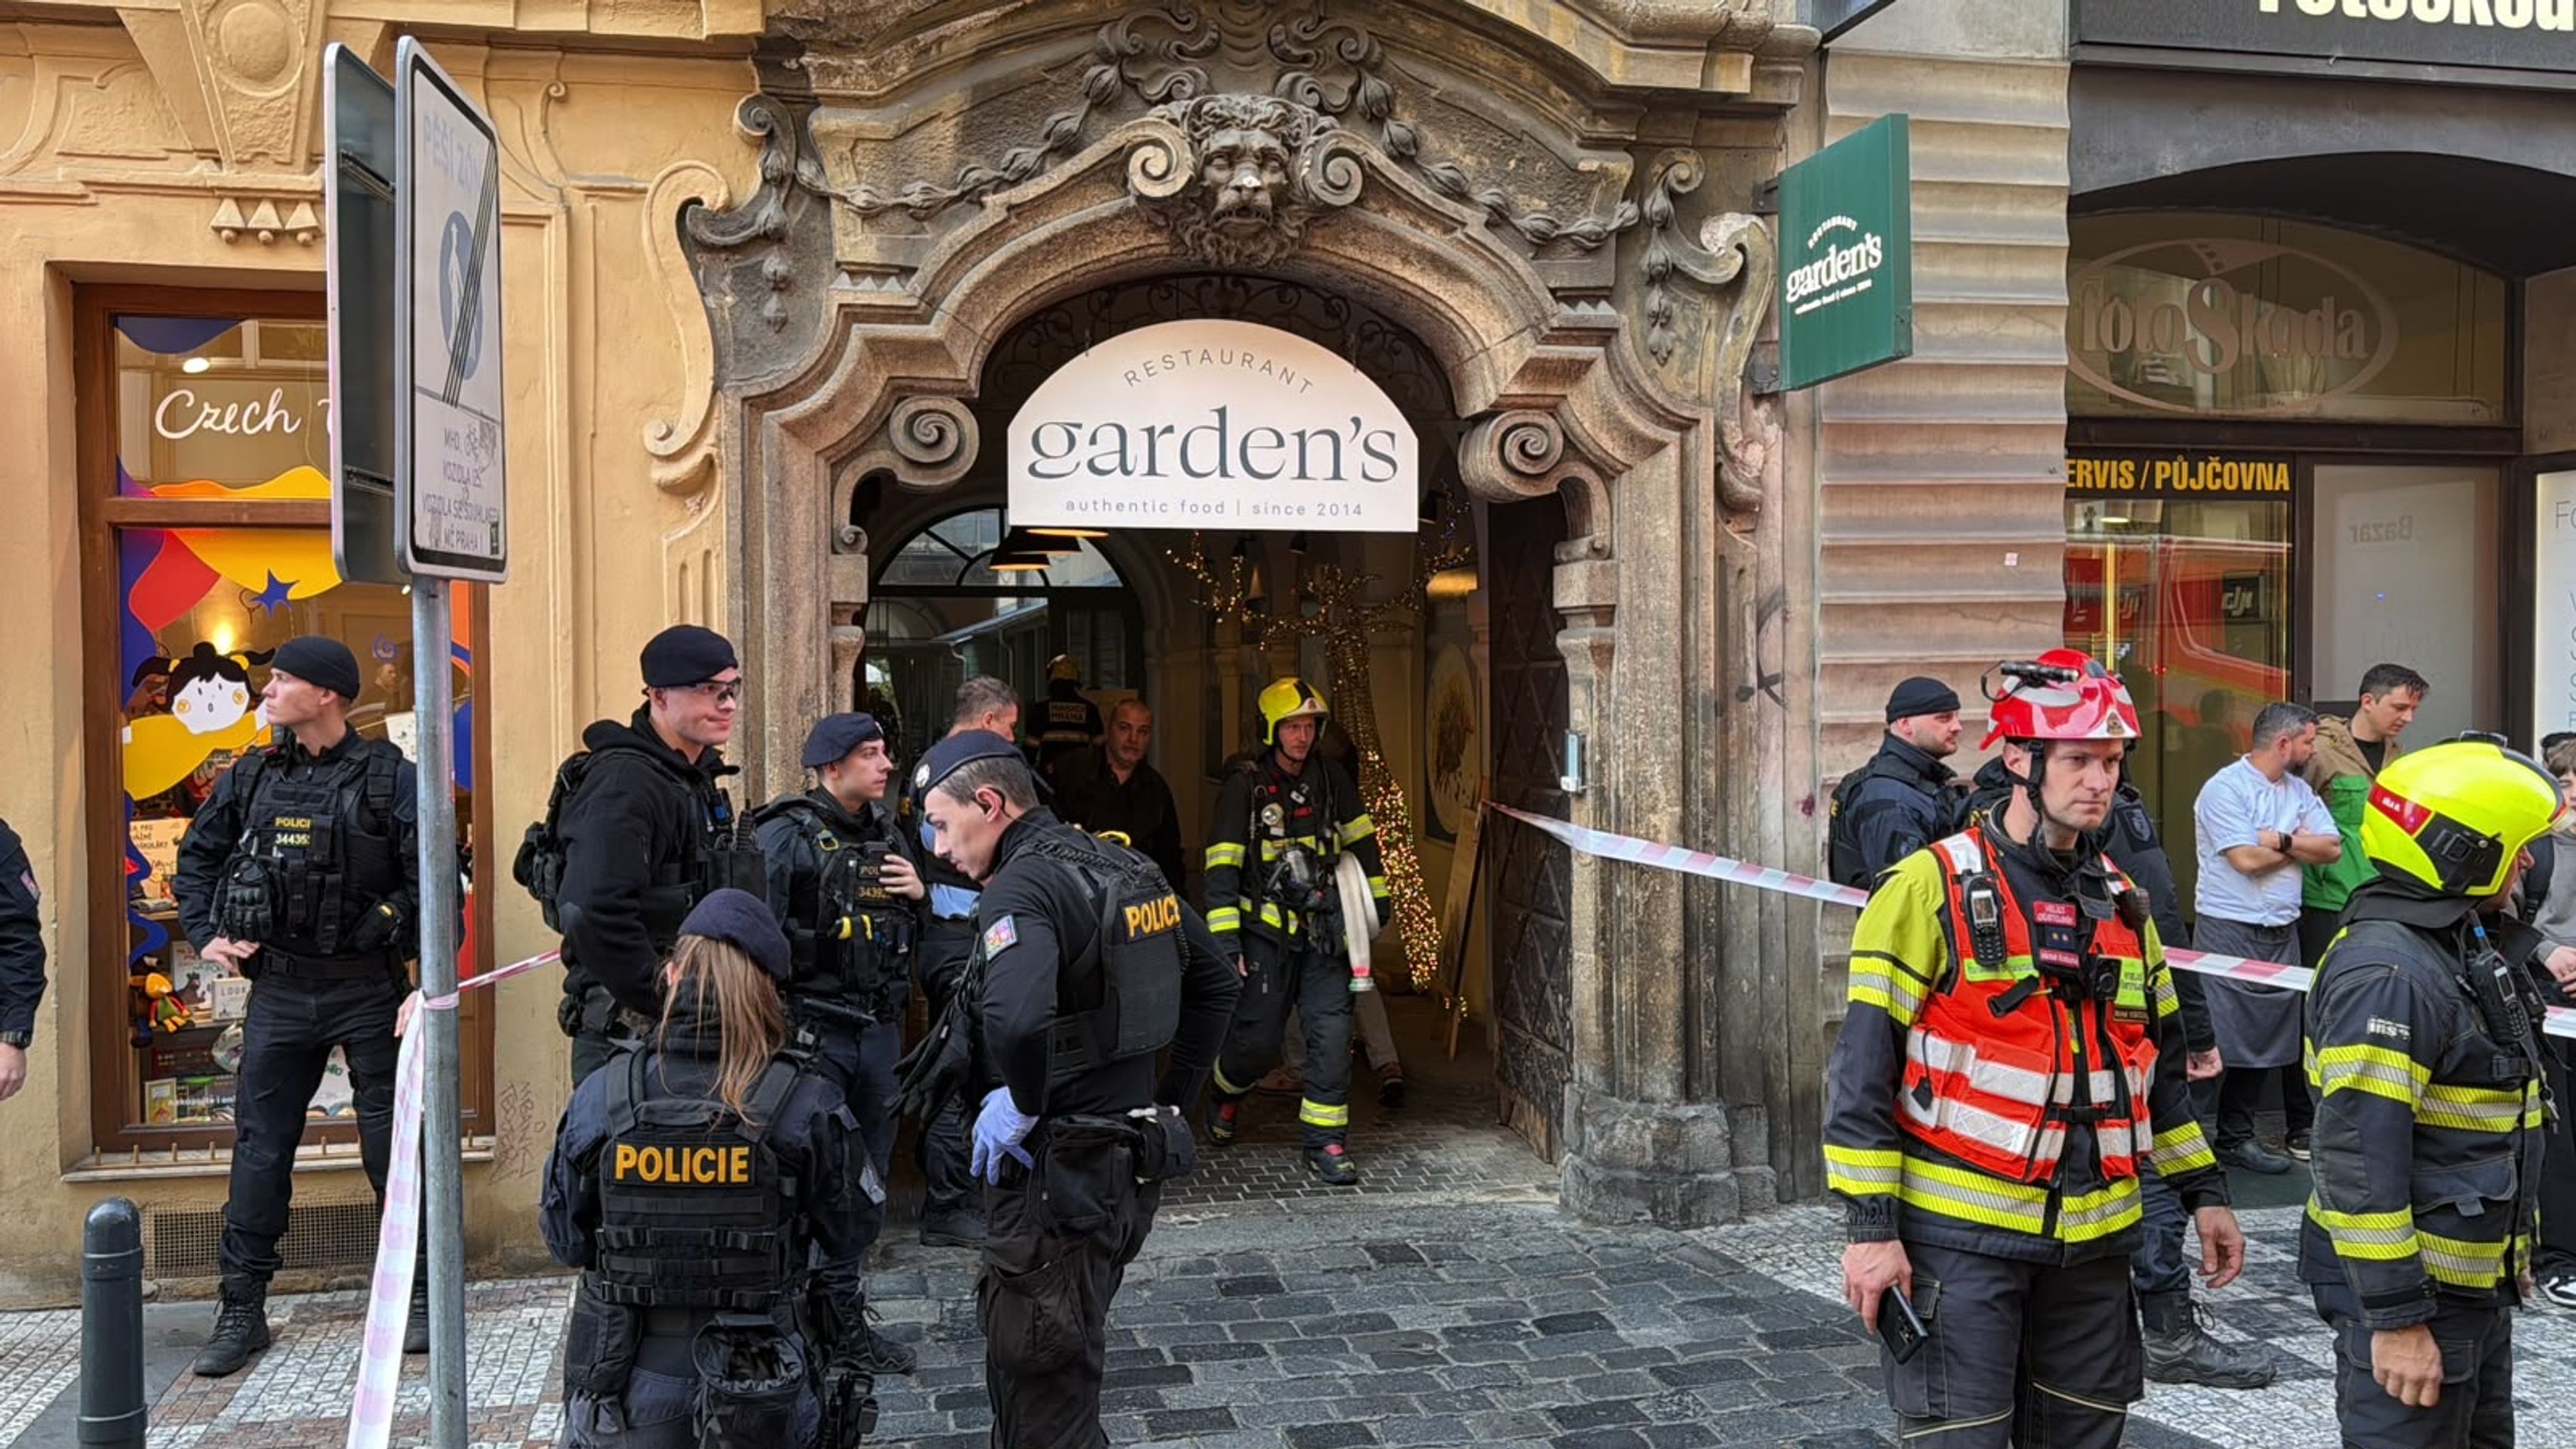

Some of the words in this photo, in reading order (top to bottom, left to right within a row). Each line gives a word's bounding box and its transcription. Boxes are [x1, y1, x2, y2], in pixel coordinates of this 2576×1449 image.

[1125, 348, 1313, 395] RESTAURANT
[155, 387, 302, 440] Czech
[1027, 405, 1398, 482] garden's
[2155, 454, 2290, 491] PŮJČOVNA
[1065, 497, 1169, 513] authentic
[1180, 498, 1226, 515] food
[1252, 499, 1306, 517] since
[1316, 502, 1363, 517] 2014
[615, 1144, 749, 1183] POLICIE
